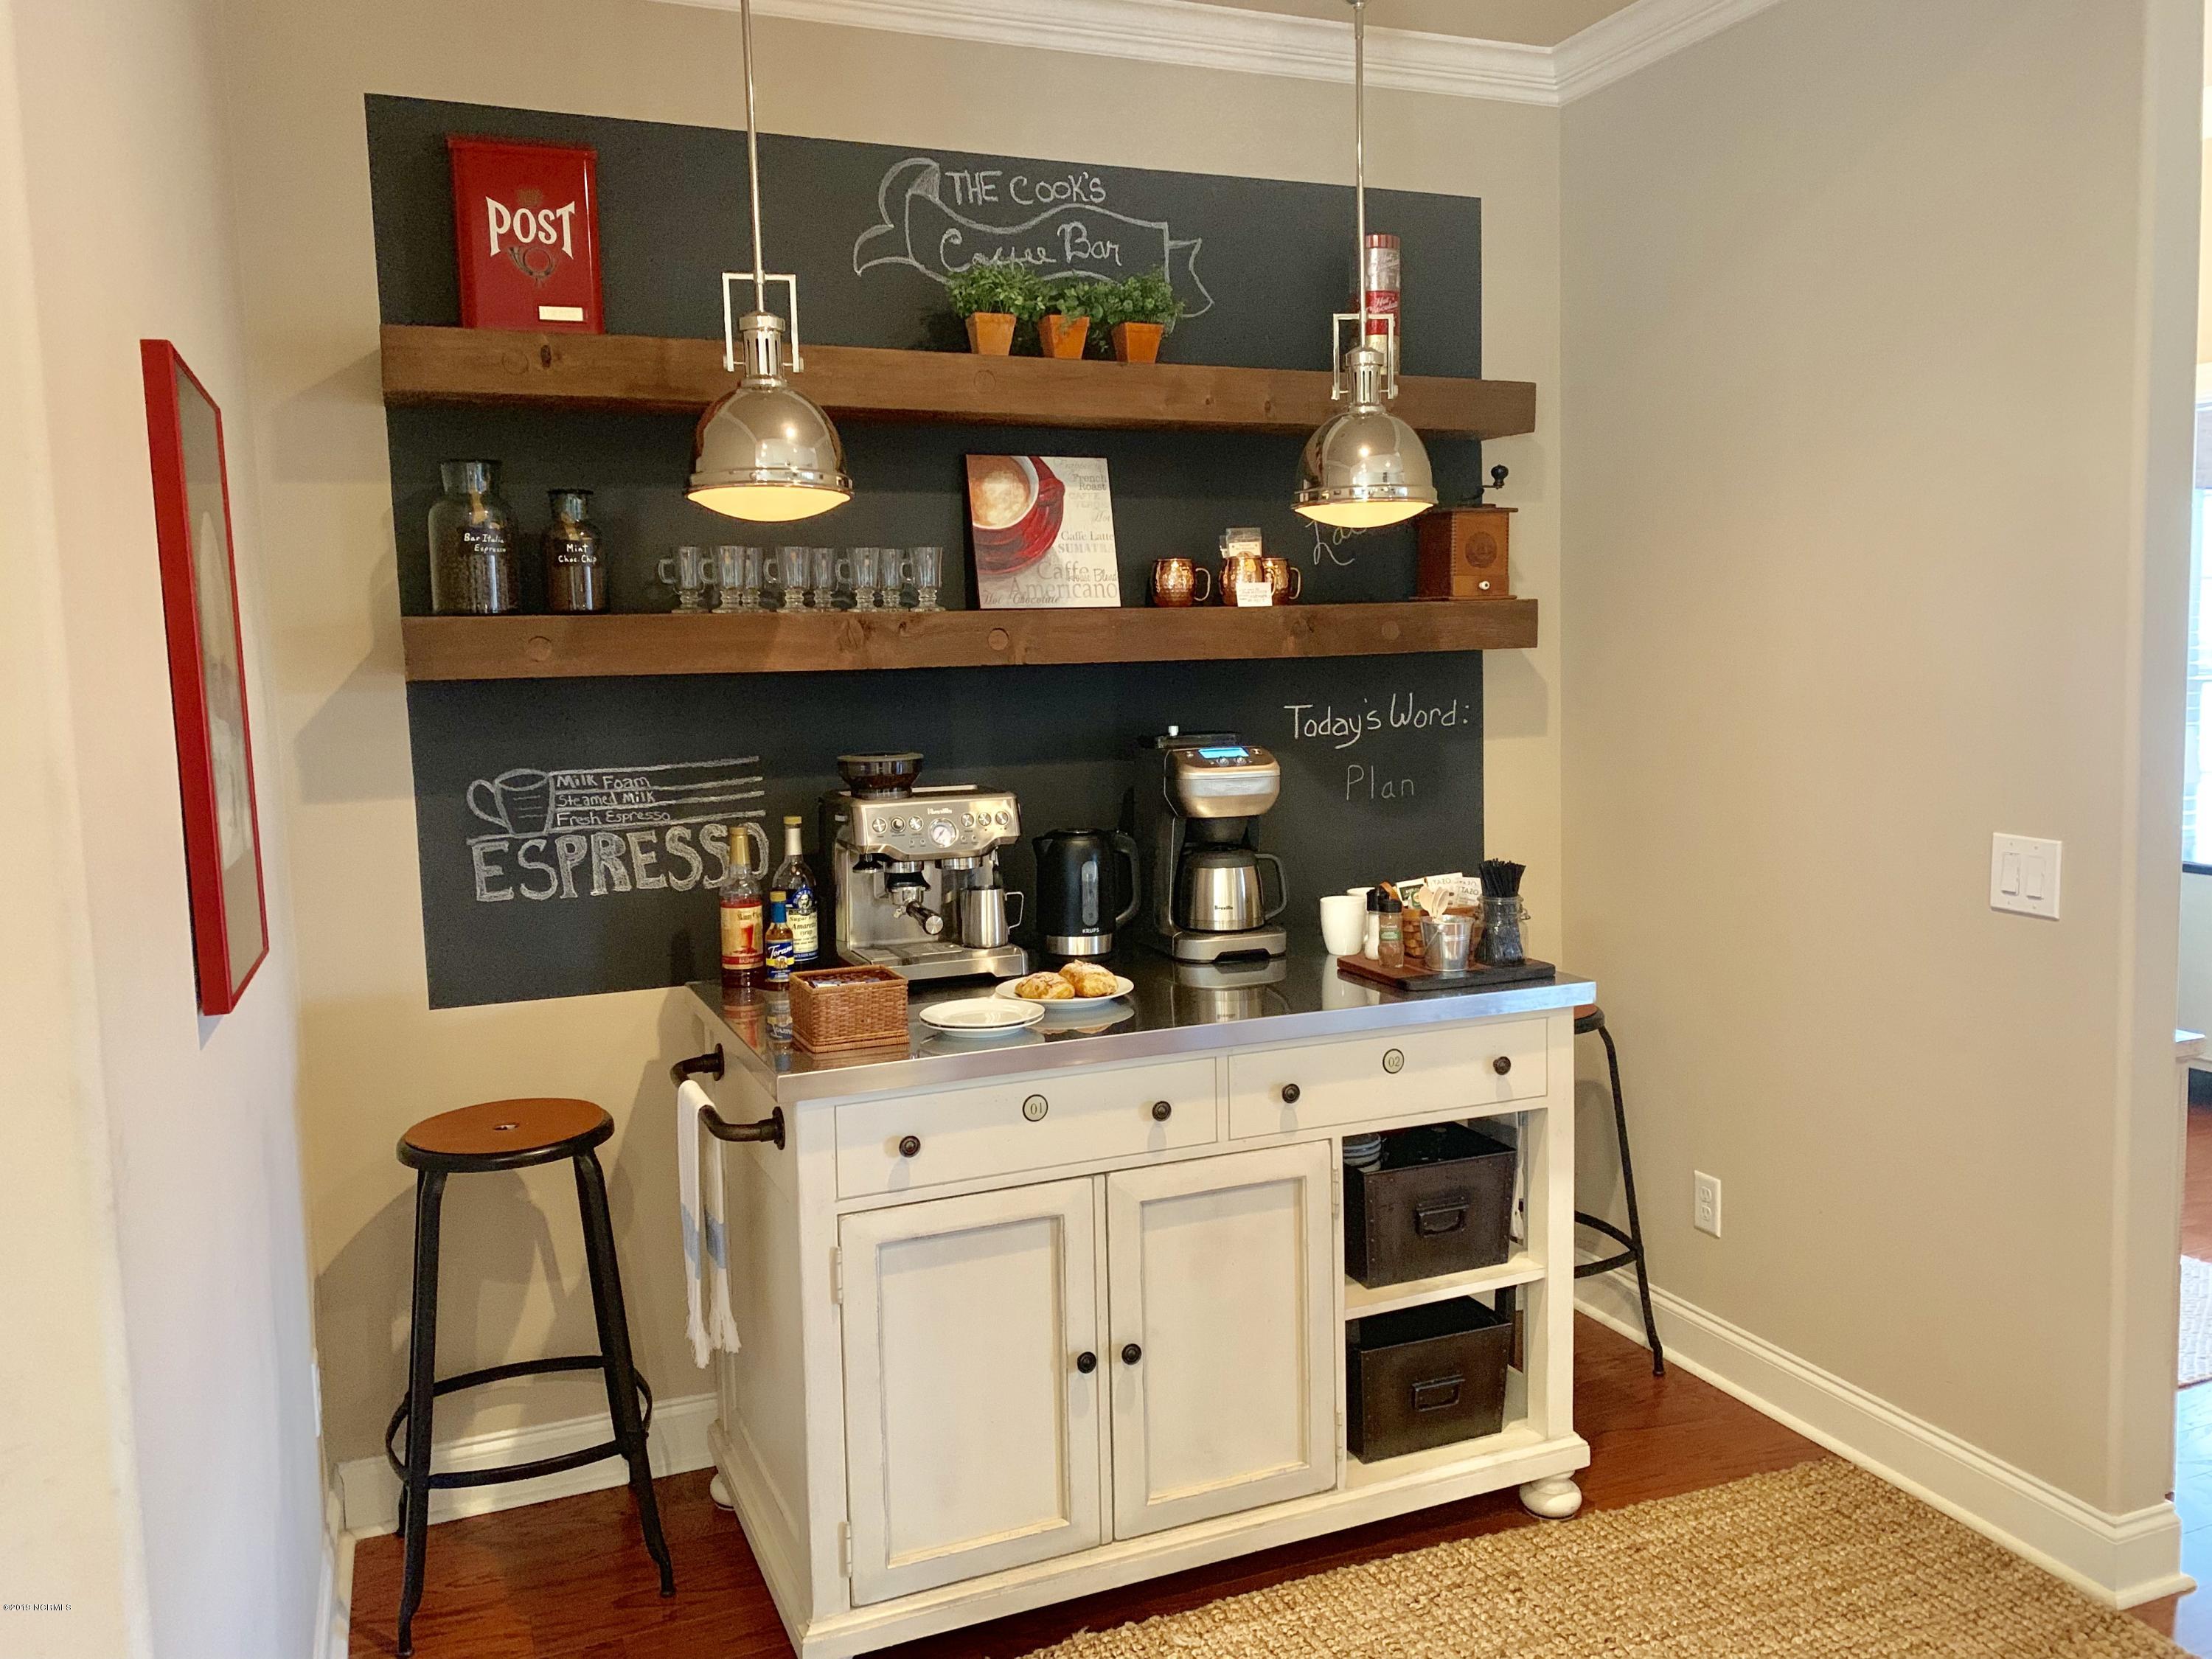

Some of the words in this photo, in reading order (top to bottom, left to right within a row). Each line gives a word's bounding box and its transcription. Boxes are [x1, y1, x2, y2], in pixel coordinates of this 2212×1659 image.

[945, 170, 1003, 206] THE
[1009, 170, 1106, 205] COOK'S
[485, 195, 576, 260] POST
[1057, 220, 1122, 266] Bar
[1073, 473, 1107, 483] French
[1079, 483, 1107, 491] Roast
[464, 532, 480, 541] Bar
[1061, 530, 1086, 541] Caffe
[1090, 530, 1115, 541] Latte
[474, 543, 507, 554] Espresso
[566, 543, 589, 553] Mint
[581, 554, 597, 566] Chip
[1037, 561, 1089, 580] Caffe
[1009, 577, 1118, 599] Americano
[1283, 697, 1382, 750] Today's
[1389, 692, 1470, 729] Word:
[557, 774, 598, 788] Milk
[602, 775, 651, 790] Foam
[1346, 764, 1415, 801] Plan
[556, 791, 619, 807] Steamed
[622, 790, 655, 804] Milk
[557, 811, 602, 827] Fresh
[605, 810, 671, 824] Espresso
[1388, 1055, 1400, 1068] 02
